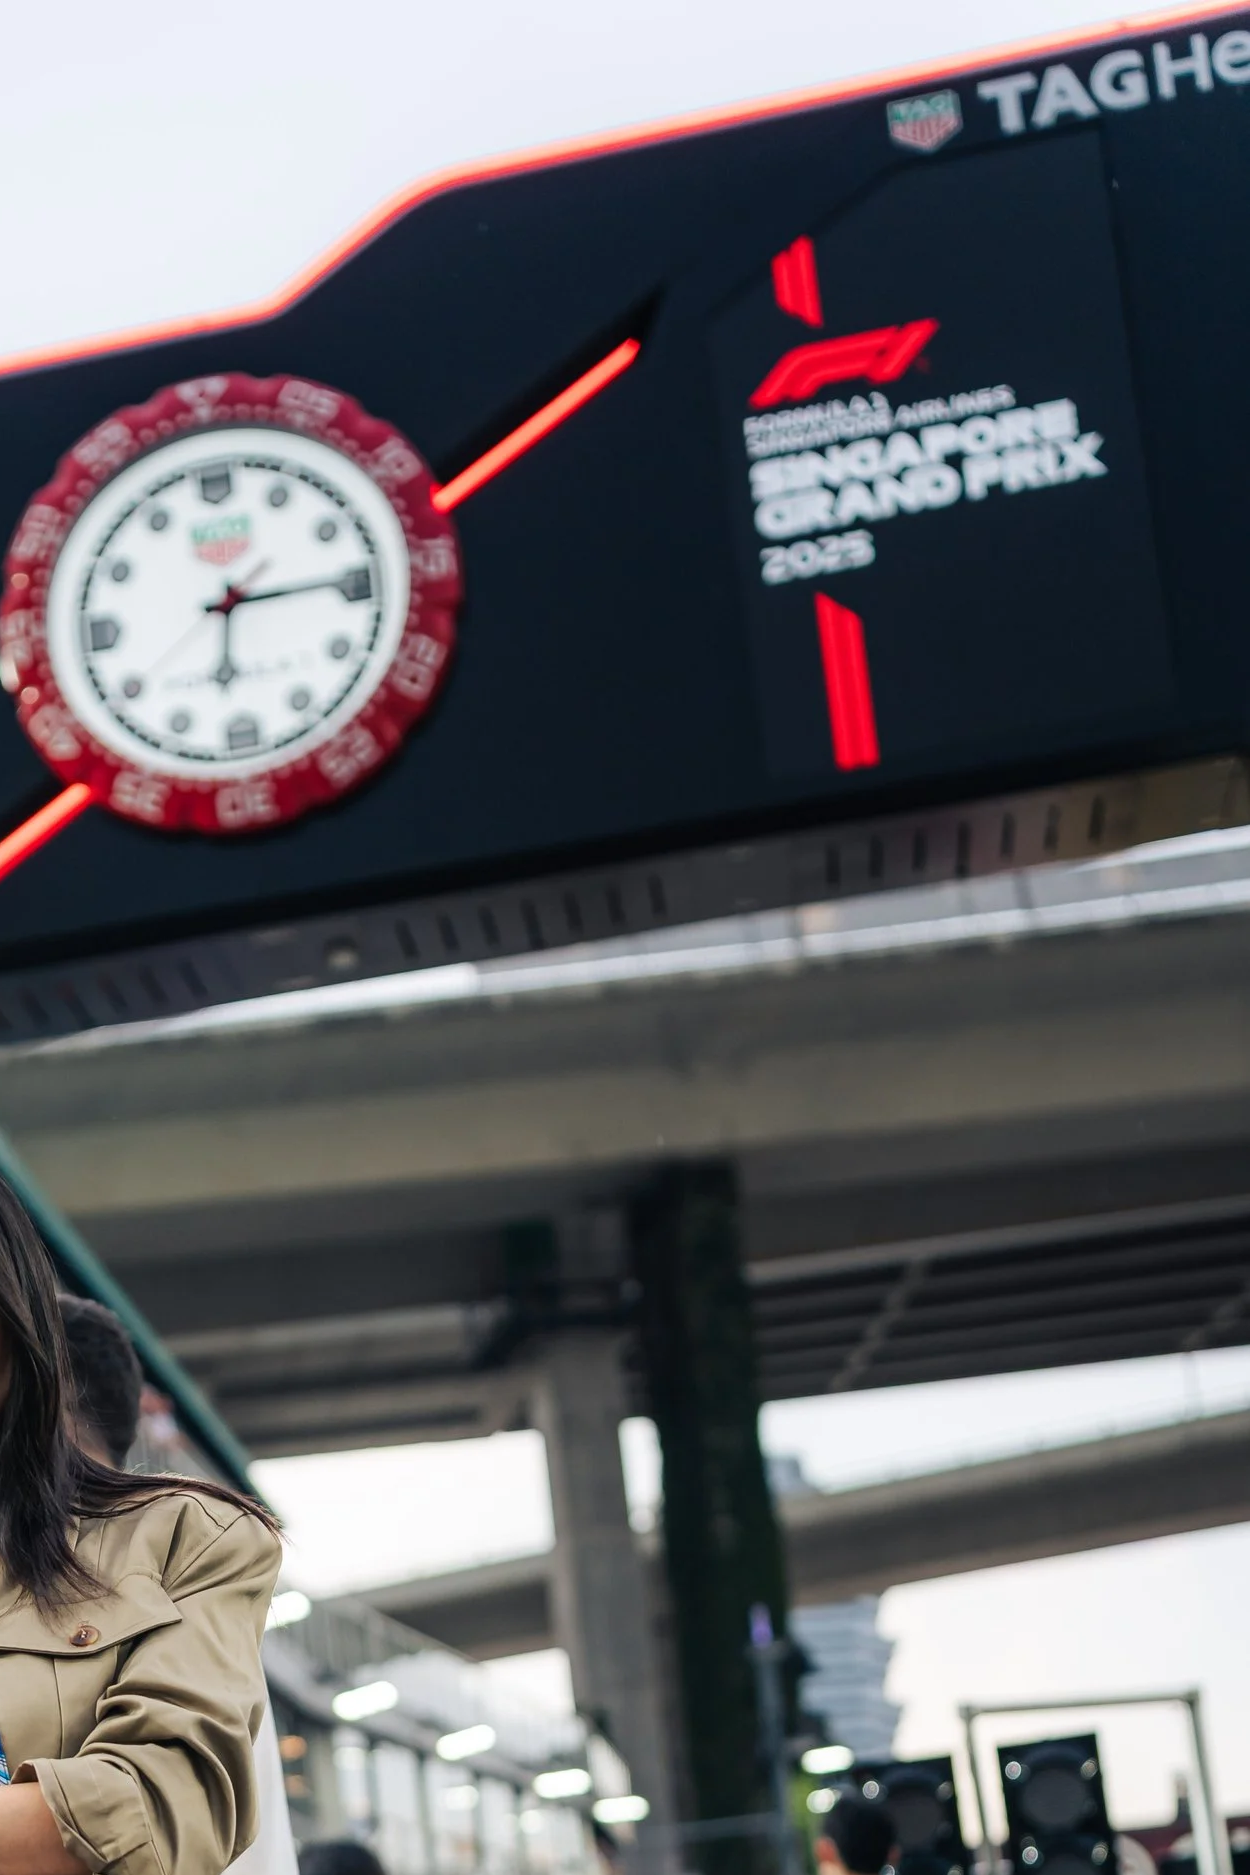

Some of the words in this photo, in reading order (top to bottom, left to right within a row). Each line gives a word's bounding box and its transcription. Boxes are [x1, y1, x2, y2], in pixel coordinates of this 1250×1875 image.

[749, 398, 1080, 501] SINGAPORE
[754, 463, 962, 539] GRAND
[962, 431, 1109, 501] PRIX
[760, 528, 876, 586] 2025
